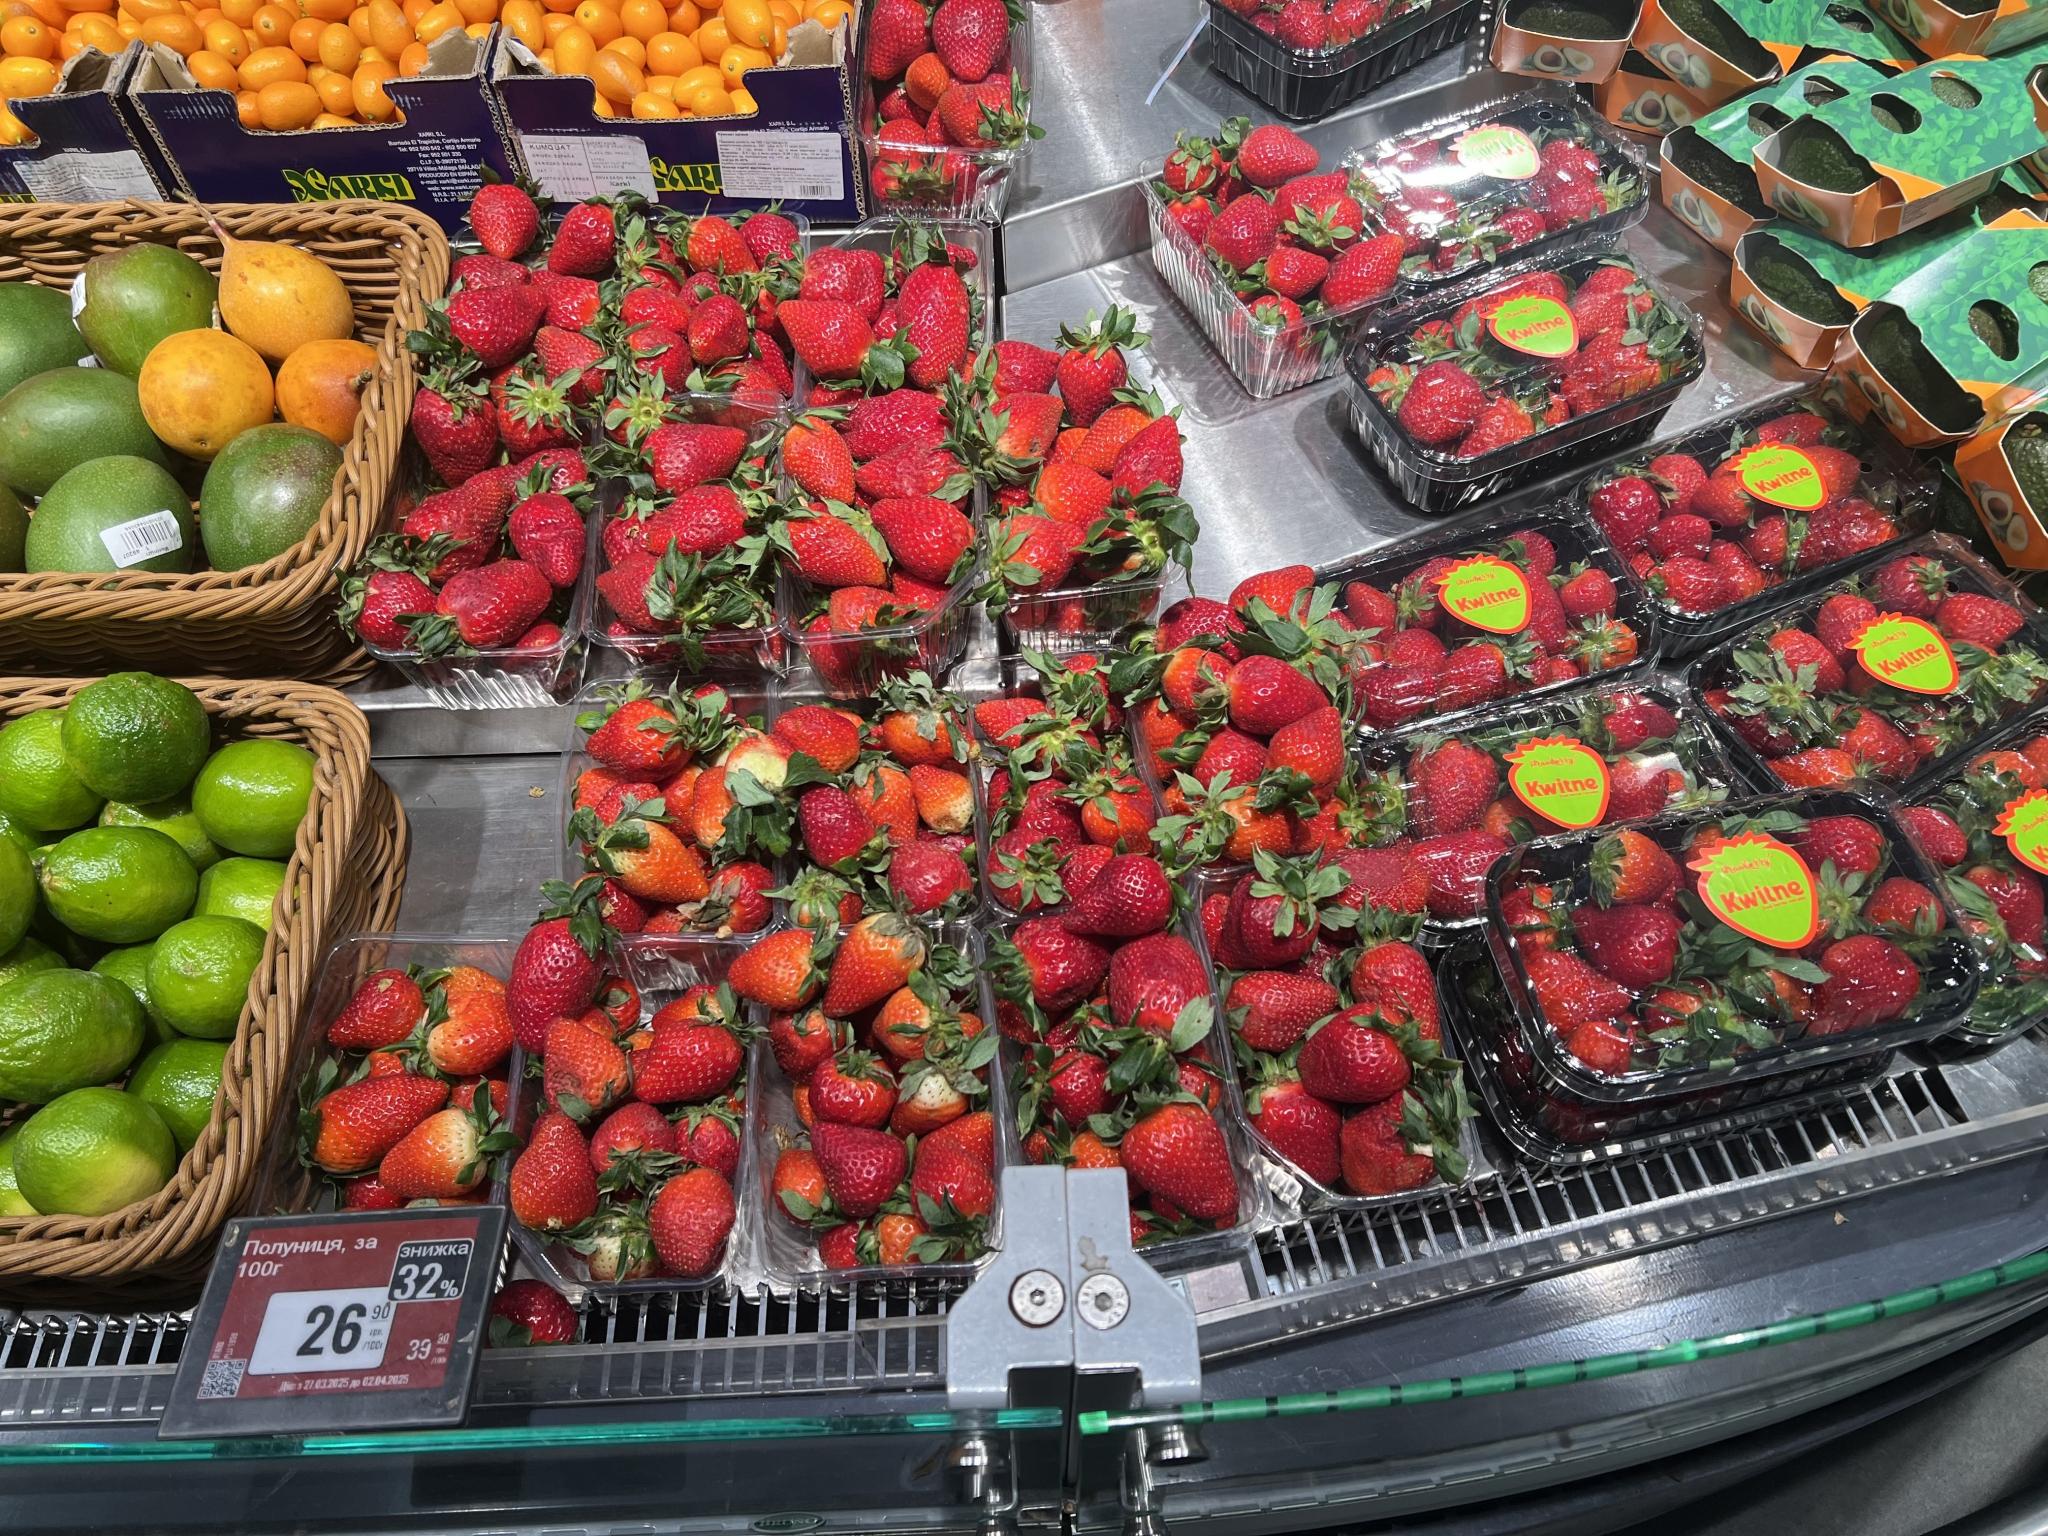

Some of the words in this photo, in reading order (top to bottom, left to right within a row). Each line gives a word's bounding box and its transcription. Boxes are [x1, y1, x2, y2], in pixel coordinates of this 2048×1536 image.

[1506, 316, 1567, 341] Kwitne
[1754, 467, 1812, 493] Kwitne
[1455, 587, 1521, 612] Kwitne
[1878, 643, 1939, 675] Kwitne
[1524, 778, 1599, 797] Kwitne
[1720, 880, 1804, 913] Kwitne
[242, 1239, 346, 1257] Полуниця,
[354, 1237, 378, 1250] за
[400, 1243, 469, 1258] знижка
[238, 1260, 283, 1278] 100г
[371, 1301, 391, 1320] 90
[296, 1303, 367, 1357] 26
[406, 1338, 432, 1360] 39
[303, 1377, 350, 1390] 27.03.2025
[362, 1374, 409, 1387] 02.04.2025
